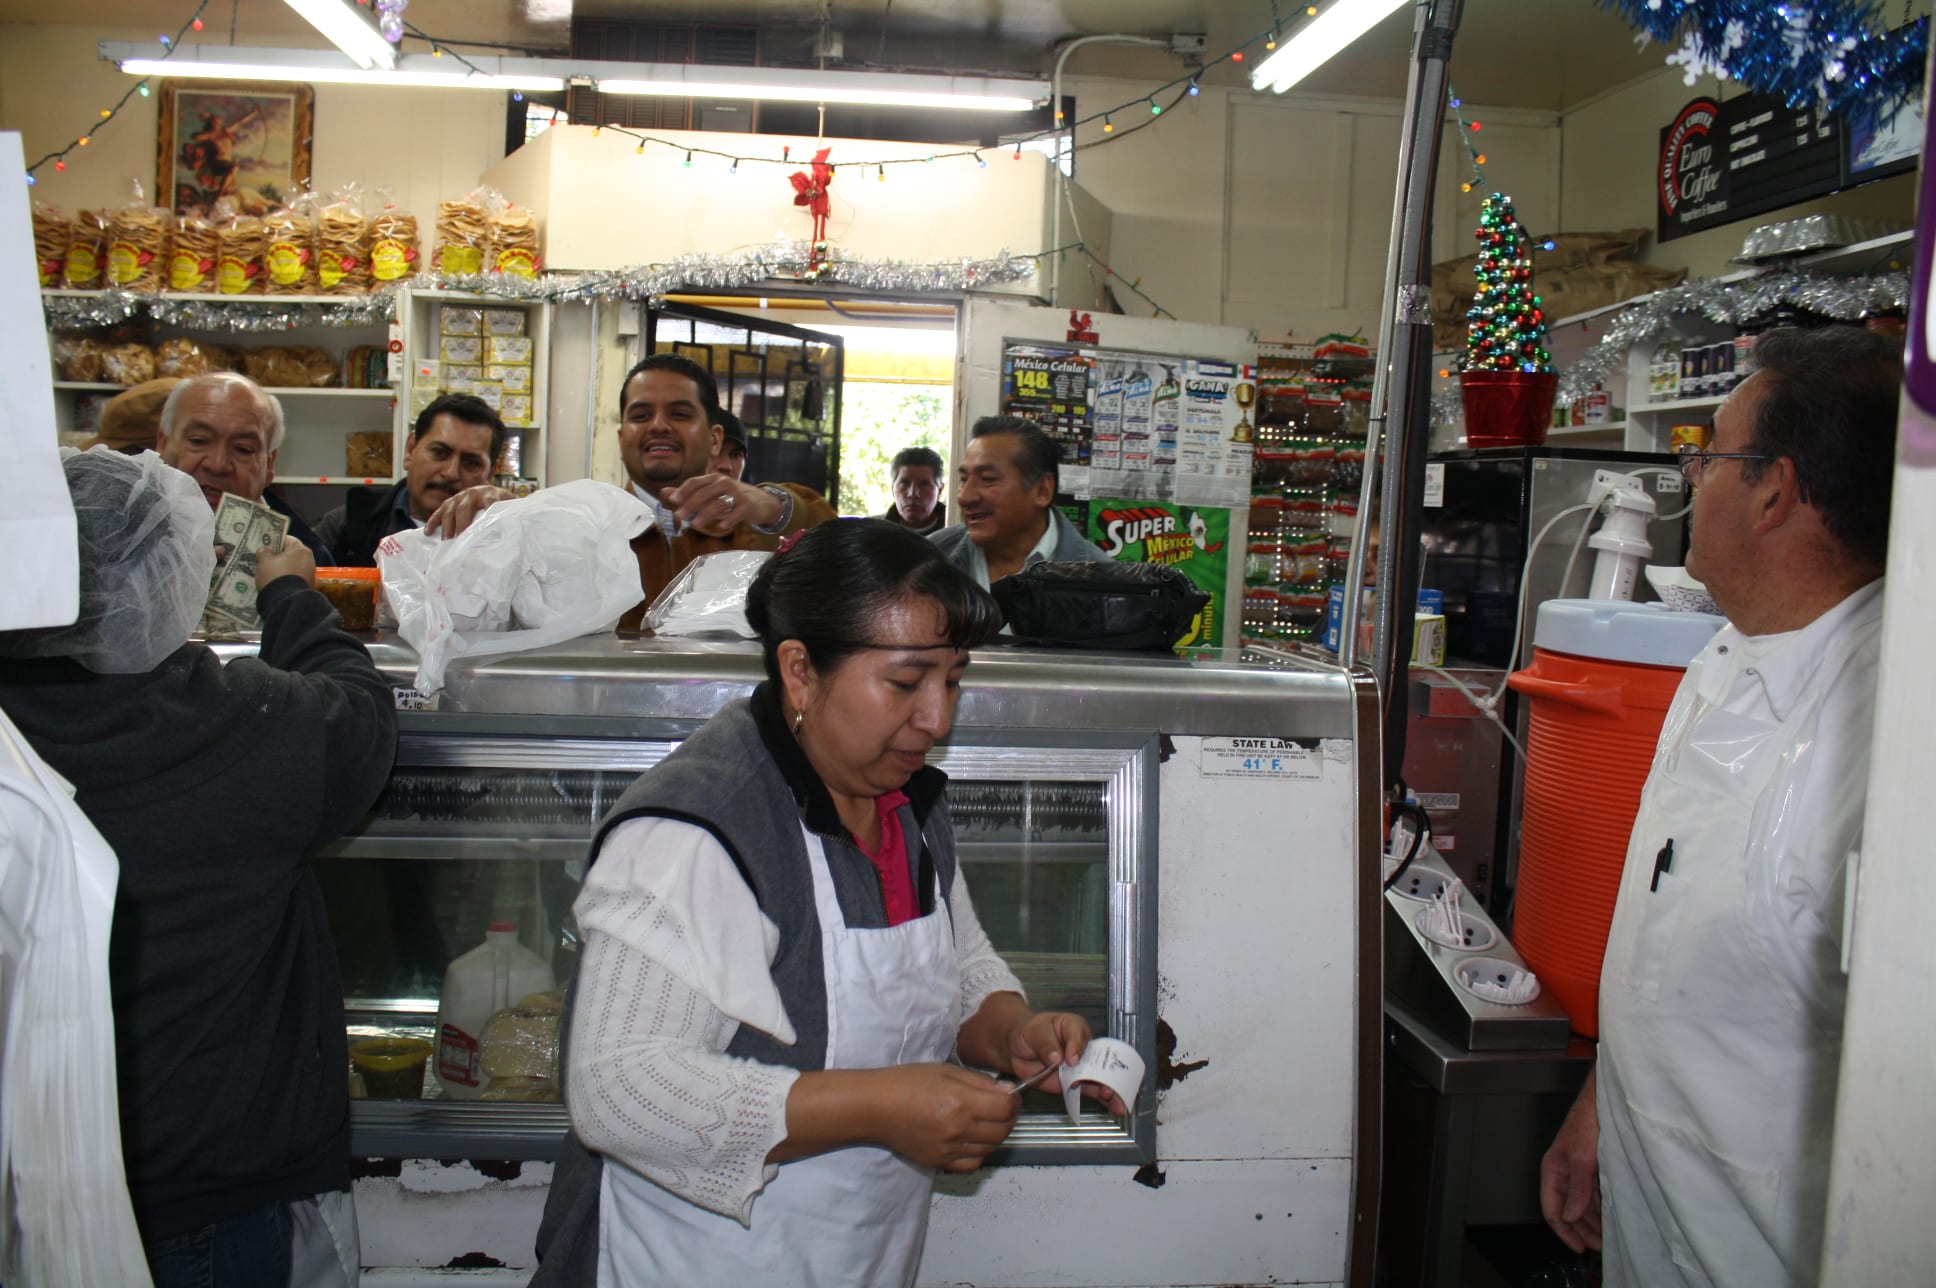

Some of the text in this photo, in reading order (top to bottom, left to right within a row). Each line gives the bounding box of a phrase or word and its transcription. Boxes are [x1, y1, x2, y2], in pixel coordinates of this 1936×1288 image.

[1679, 143, 1712, 173] Euro
[1014, 358, 1088, 374] México Celular
[1014, 370, 1049, 390] 148
[1107, 516, 1175, 557] SUPER
[1146, 535, 1195, 556] MÉXICO
[1233, 739, 1293, 749] STATE LAW
